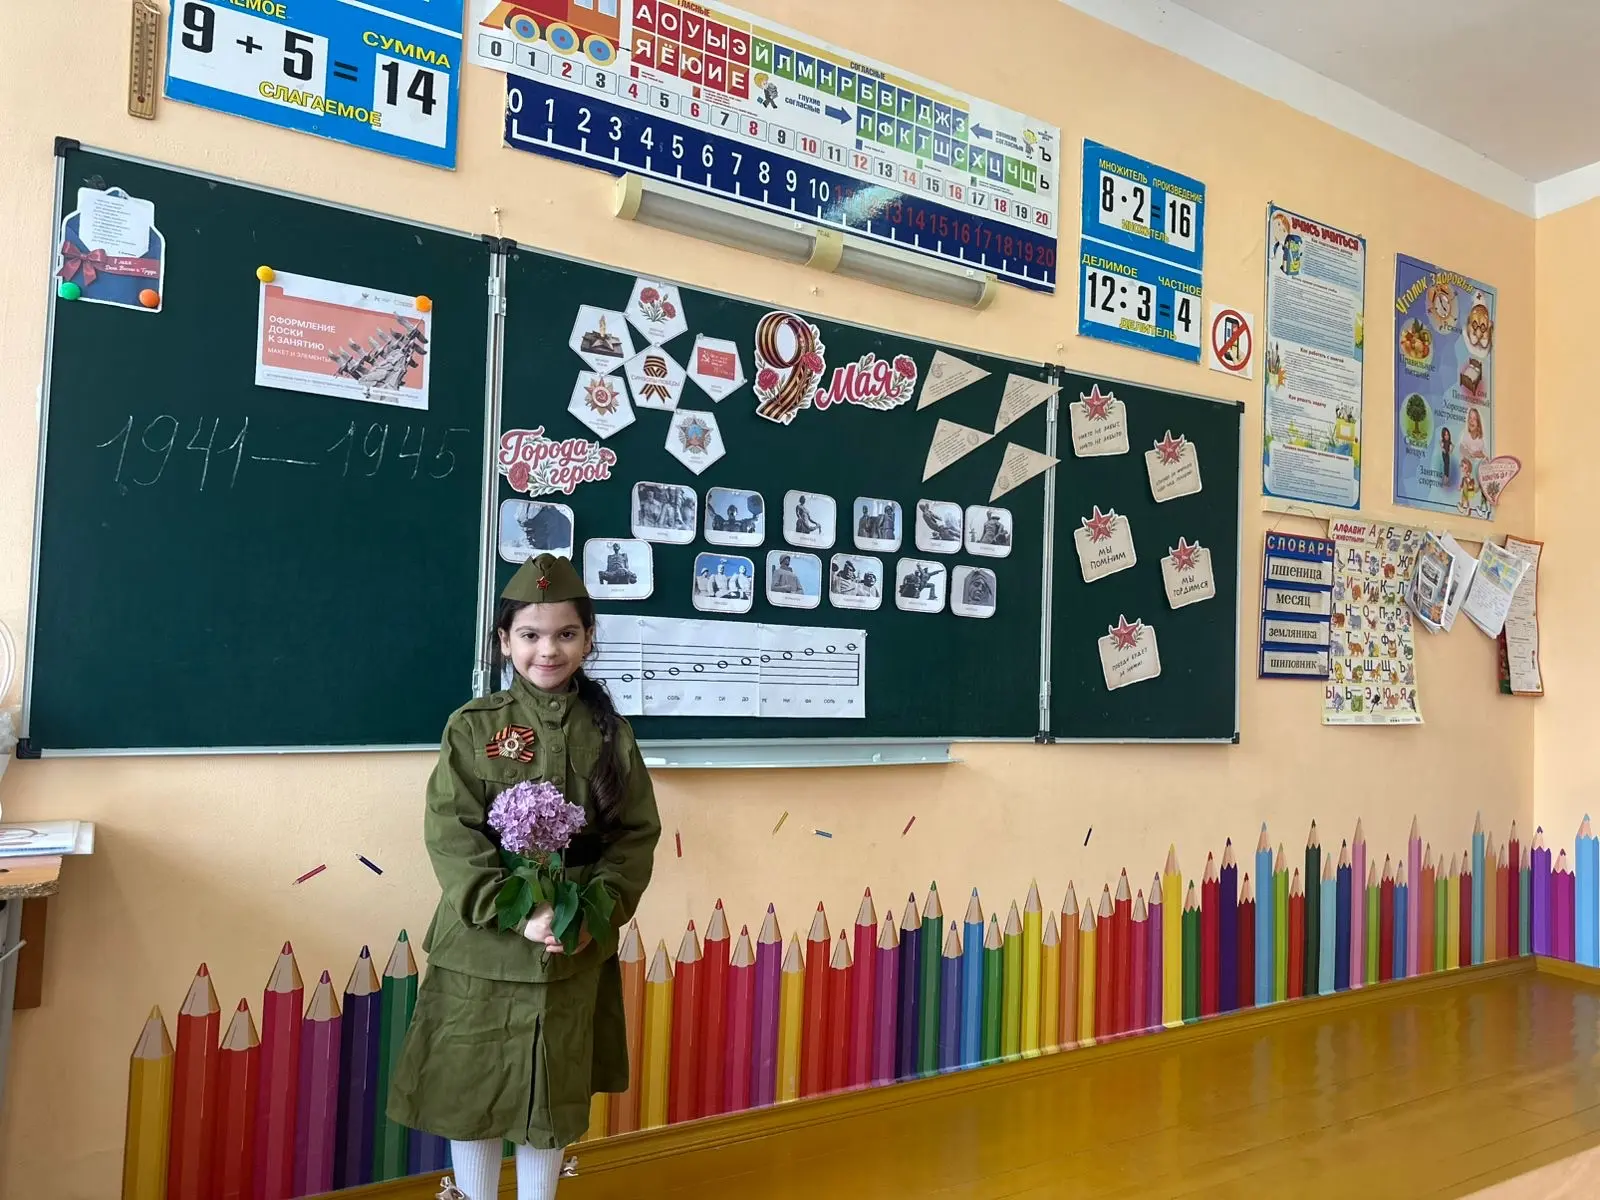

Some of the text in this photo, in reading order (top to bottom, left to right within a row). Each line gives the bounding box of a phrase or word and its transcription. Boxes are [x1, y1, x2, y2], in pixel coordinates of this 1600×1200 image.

[636, 4, 747, 56] А О У Ы Э
[182, 1, 436, 115] 9 5 14
[362, 31, 451, 68] СУММА
[636, 39, 745, 89] Я Ё Ю И Е
[755, 42, 965, 133] Й Л М Н Р Б В Г Д Ж З
[259, 81, 382, 127] СЛАГАЕМОЕ
[491, 41, 501, 56] 0
[528, 51, 536, 66] 1
[562, 62, 572, 77] 2
[596, 73, 606, 88] 3
[628, 83, 638, 98] 4
[660, 92, 669, 108] 5
[690, 102, 700, 117] 6
[720, 112, 730, 126] 7
[749, 121, 758, 136] 8
[778, 130, 786, 144] 9
[802, 137, 817, 153] 10
[827, 146, 841, 162] 11
[853, 154, 868, 170] 12
[879, 162, 893, 177] 13
[903, 170, 916, 185] 14
[926, 177, 940, 192] 15
[949, 184, 962, 200] 16
[971, 191, 985, 206] 17
[994, 199, 1007, 213] 18
[1015, 205, 1028, 219] 19
[1036, 211, 1049, 226] 20
[509, 88, 523, 113] 0
[545, 98, 555, 122] 1
[578, 108, 592, 133] 2
[608, 116, 623, 141] 3
[640, 127, 654, 150] 4
[672, 135, 684, 160] 5
[701, 144, 714, 168] 6
[731, 152, 743, 175] 7
[758, 161, 770, 184] 8
[786, 169, 797, 192] 9
[809, 178, 830, 202] 10
[861, 115, 872, 132] П
[879, 121, 893, 136] Ф
[900, 127, 910, 144] К
[918, 133, 929, 149] Т
[934, 139, 949, 158] Ш
[954, 147, 965, 162] С
[972, 152, 982, 169] Х
[990, 157, 1001, 177] Ц
[1008, 163, 1018, 179] Ч
[1022, 169, 1036, 189] Щ
[1039, 145, 1051, 162] Ъ
[1040, 174, 1050, 190] Ь
[1099, 158, 1203, 204] МНОЖИТЕЛЬ ПРОИЗВЕДЕНИЕ
[1102, 175, 1192, 238] 8 2 16
[1121, 218, 1170, 243] МНОЖИТЕЛЬ
[1081, 253, 1138, 278] ДЕЛИМОЕ
[1158, 276, 1203, 297] ЧАСТНОЕ
[1088, 272, 1192, 333] 12 3 4
[268, 315, 337, 334] ОФОРМЛЕНИЕ
[268, 325, 304, 337] ДОСКИ
[1119, 317, 1177, 341] ДЕЛИТЕЛЬ
[268, 335, 325, 351] К ЗАНЯТИЮ
[815, 361, 901, 409] Мая
[1333, 523, 1366, 536] АЛФАВИТ
[1267, 535, 1333, 557] СЛОВАРЬ
[1271, 564, 1322, 581] пшеница
[1276, 593, 1311, 608] месяц
[1268, 628, 1317, 640] земляника
[1270, 658, 1317, 669] шиповник
